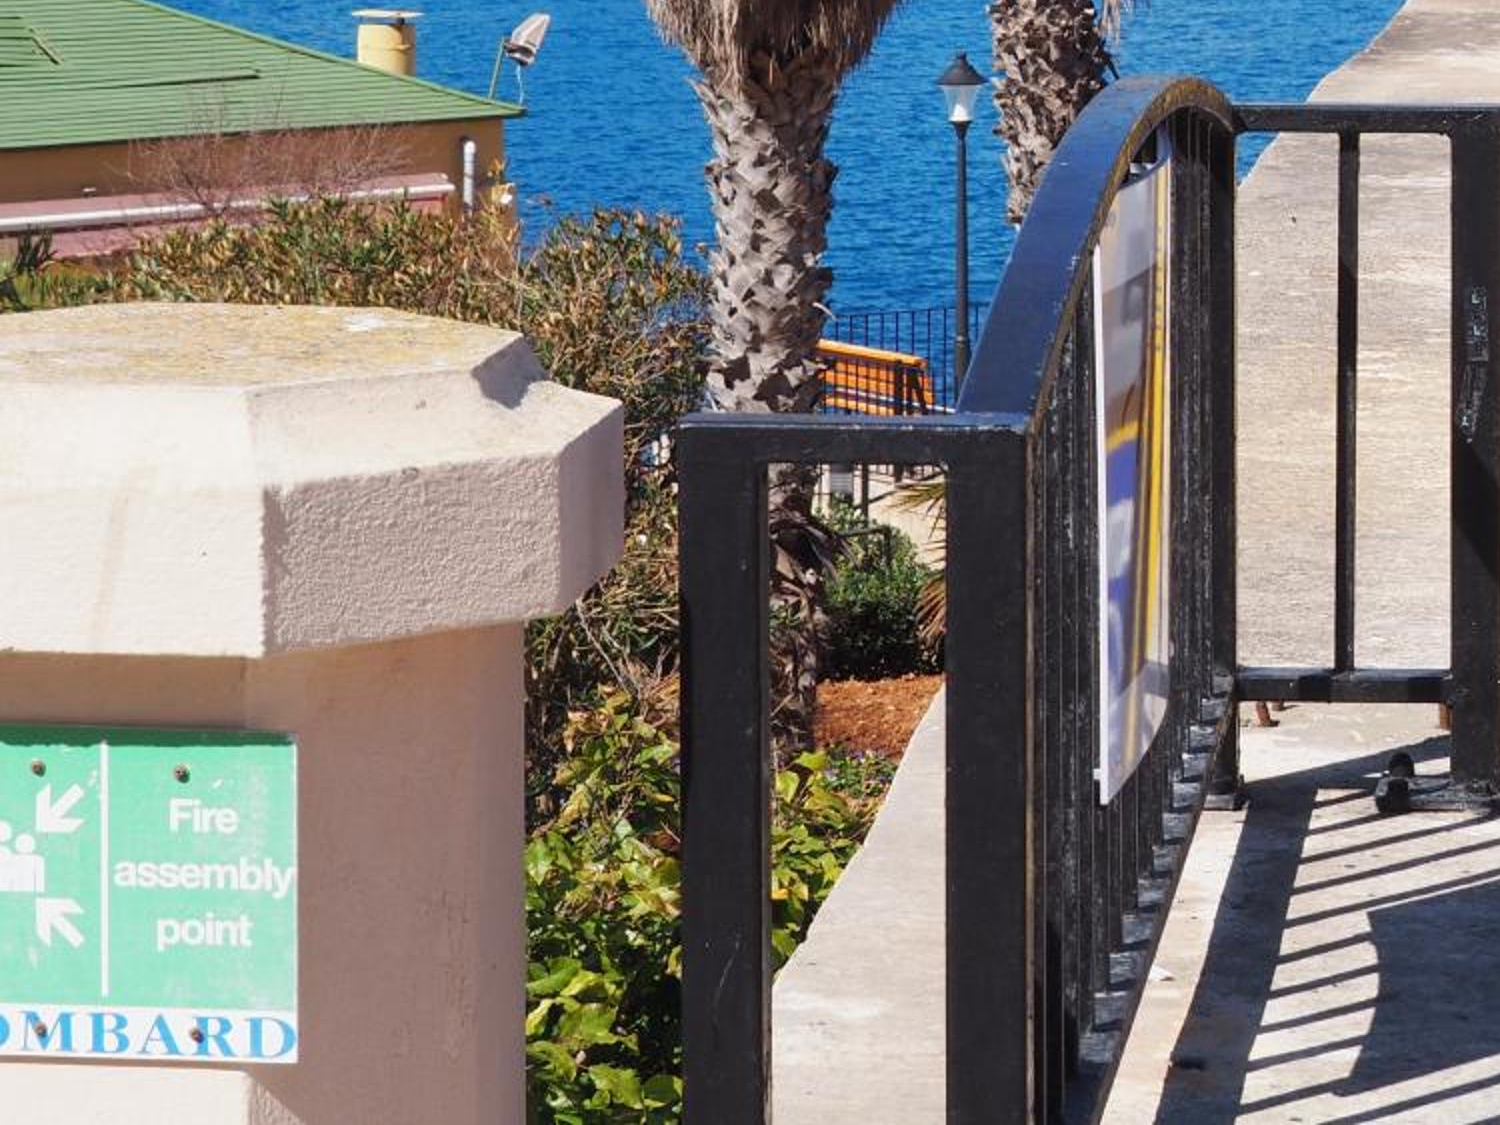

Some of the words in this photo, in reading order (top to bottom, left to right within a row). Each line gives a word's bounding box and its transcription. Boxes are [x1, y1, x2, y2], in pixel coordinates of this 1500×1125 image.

[169, 799, 239, 833] Fire
[113, 857, 295, 899] assembly
[156, 912, 254, 951] point
[0, 1009, 296, 1059] MBARD
